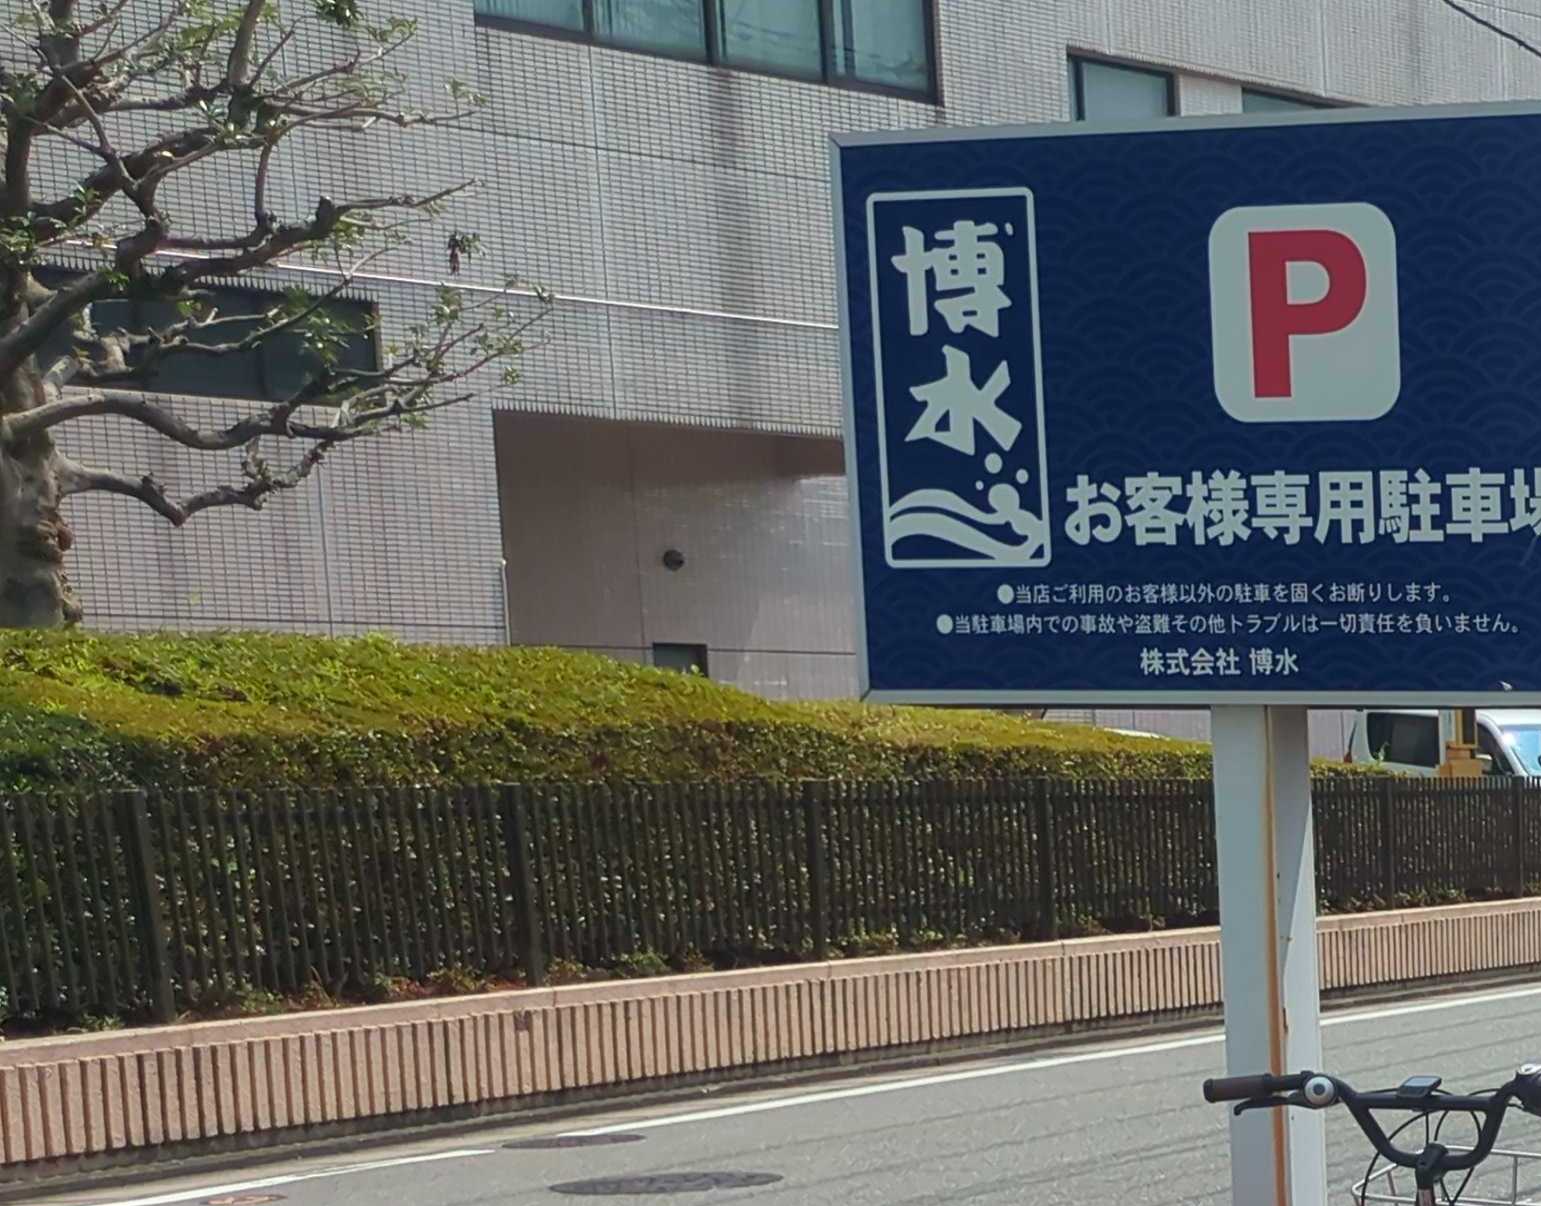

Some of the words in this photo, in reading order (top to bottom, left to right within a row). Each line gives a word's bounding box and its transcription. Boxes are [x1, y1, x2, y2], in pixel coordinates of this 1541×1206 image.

[1248, 229, 1367, 399] P
[892, 219, 1024, 455] 博水
[1015, 582, 1452, 604] 当店ご利用のお客様以外の駐車を固くお断りします。
[954, 612, 1522, 635] 当駐車場内での事故や盗難その他トラブルは一切責任を負いません。
[1140, 647, 1241, 676] 株式会社
[1249, 646, 1300, 675] 博水
